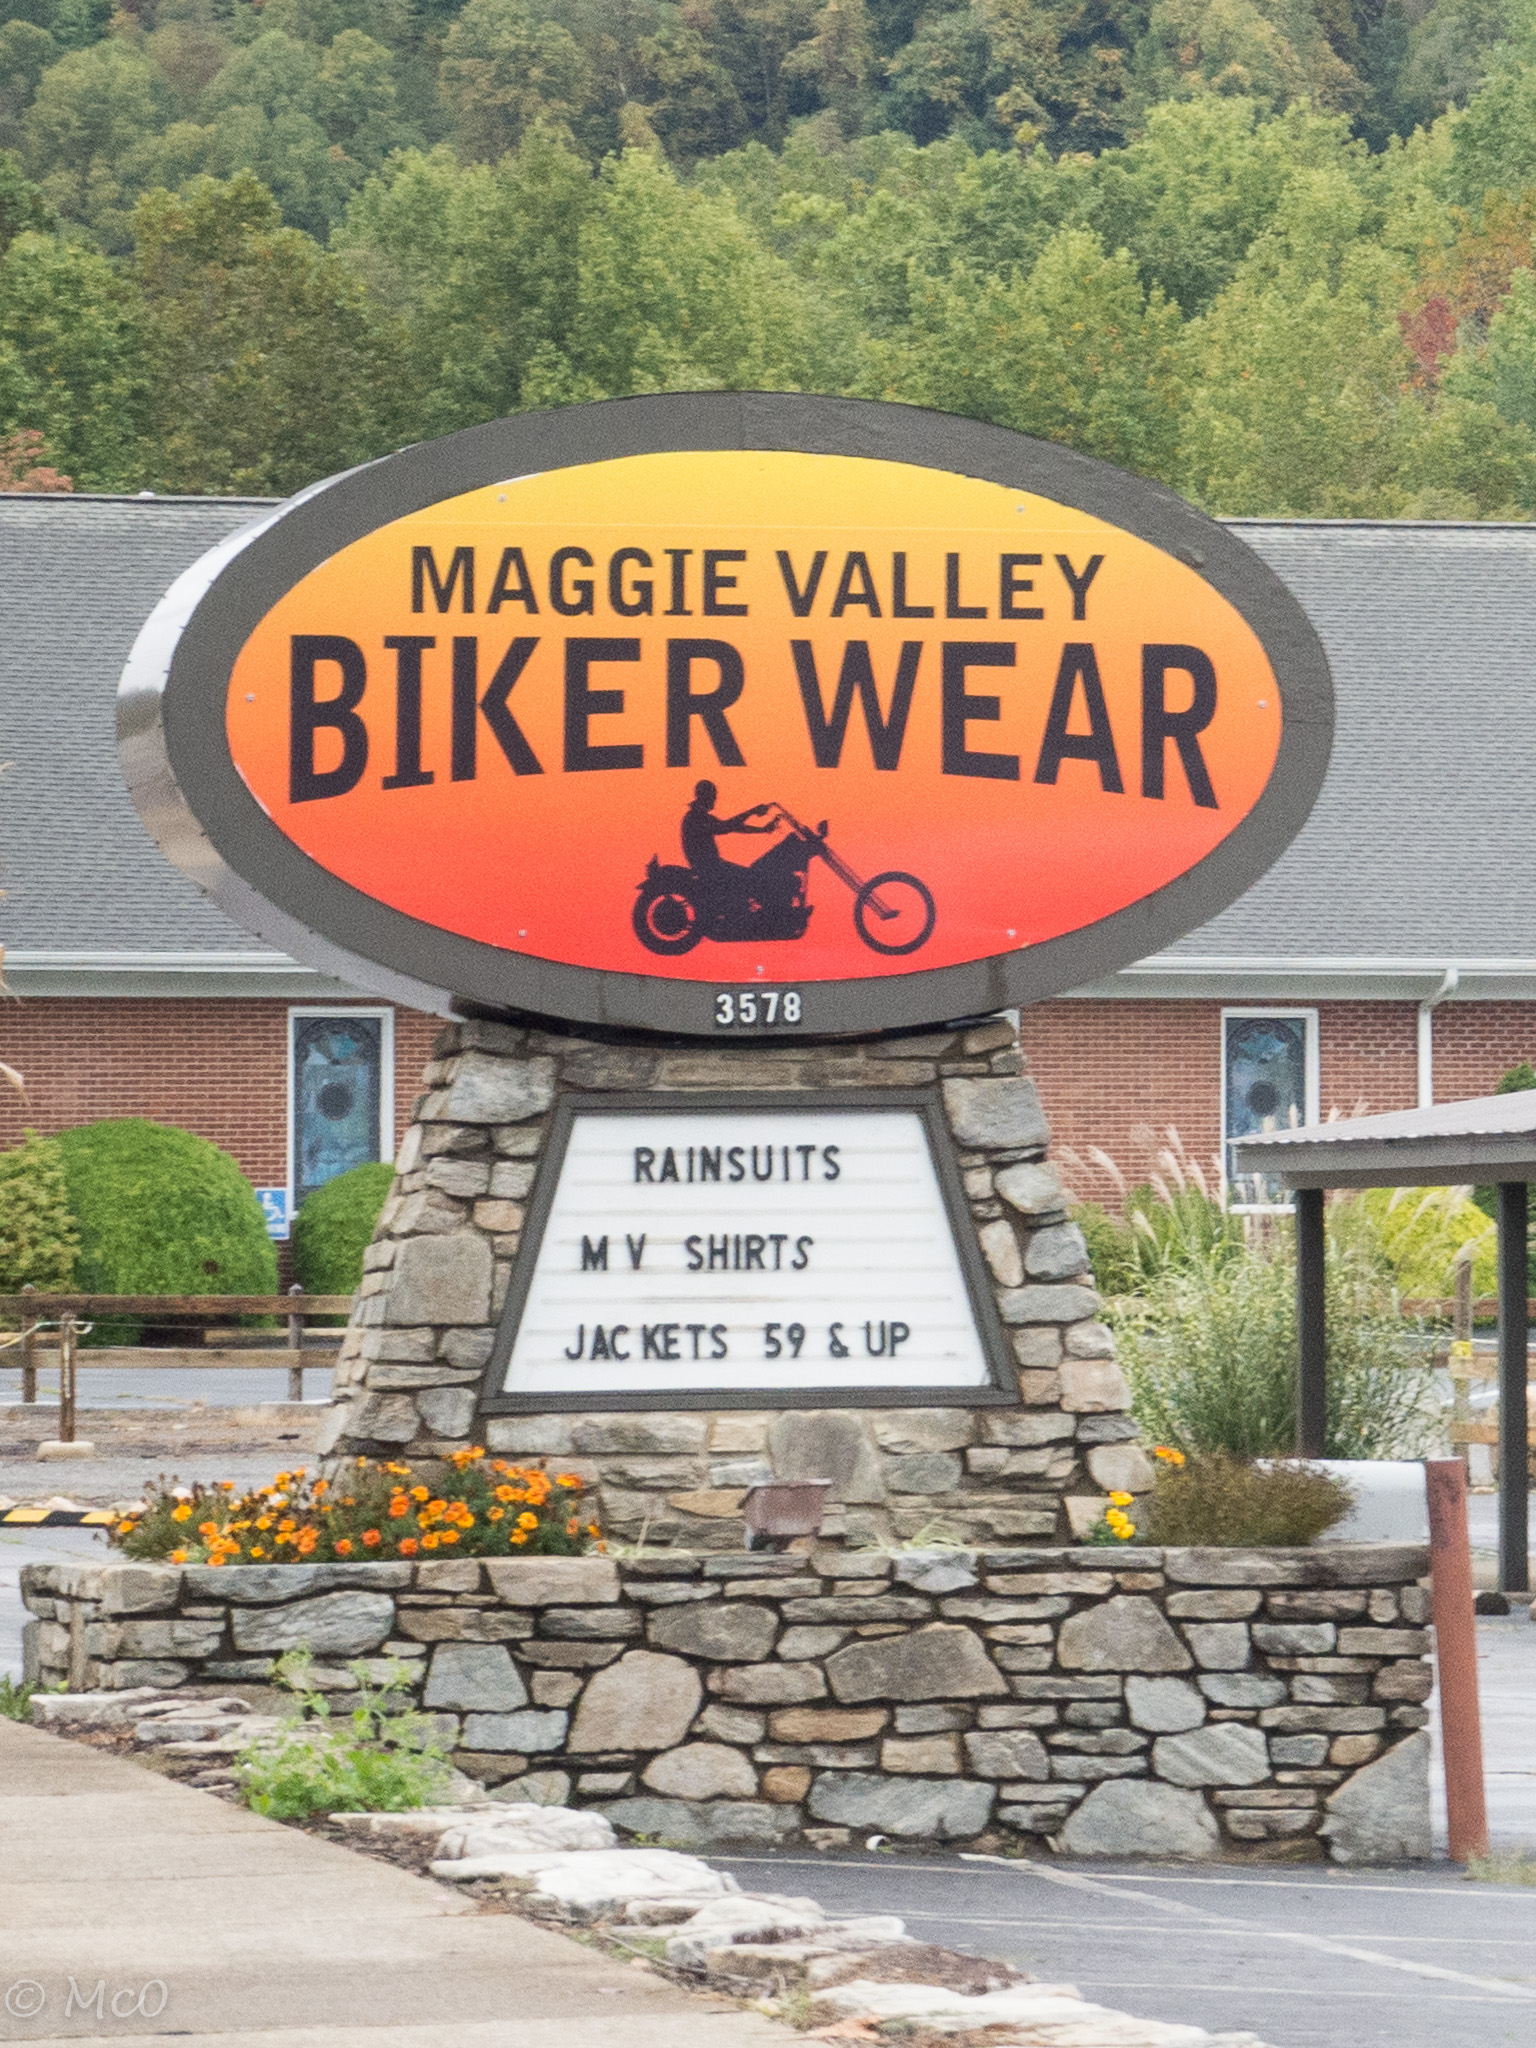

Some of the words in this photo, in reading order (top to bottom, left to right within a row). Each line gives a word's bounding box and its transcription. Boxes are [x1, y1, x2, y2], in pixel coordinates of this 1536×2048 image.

[410, 546, 748, 617] MAGGIE
[776, 549, 1105, 621] VALLEY
[289, 634, 747, 804] BIKER
[790, 639, 1219, 810] WEAR
[715, 991, 802, 1025] 3578
[633, 1145, 841, 1183] RAINSUITS
[684, 1233, 814, 1271] SHIRTS
[565, 1323, 728, 1360] JACKETS
[764, 1322, 806, 1359] 59
[828, 1323, 850, 1358] &
[865, 1321, 911, 1357] UP
